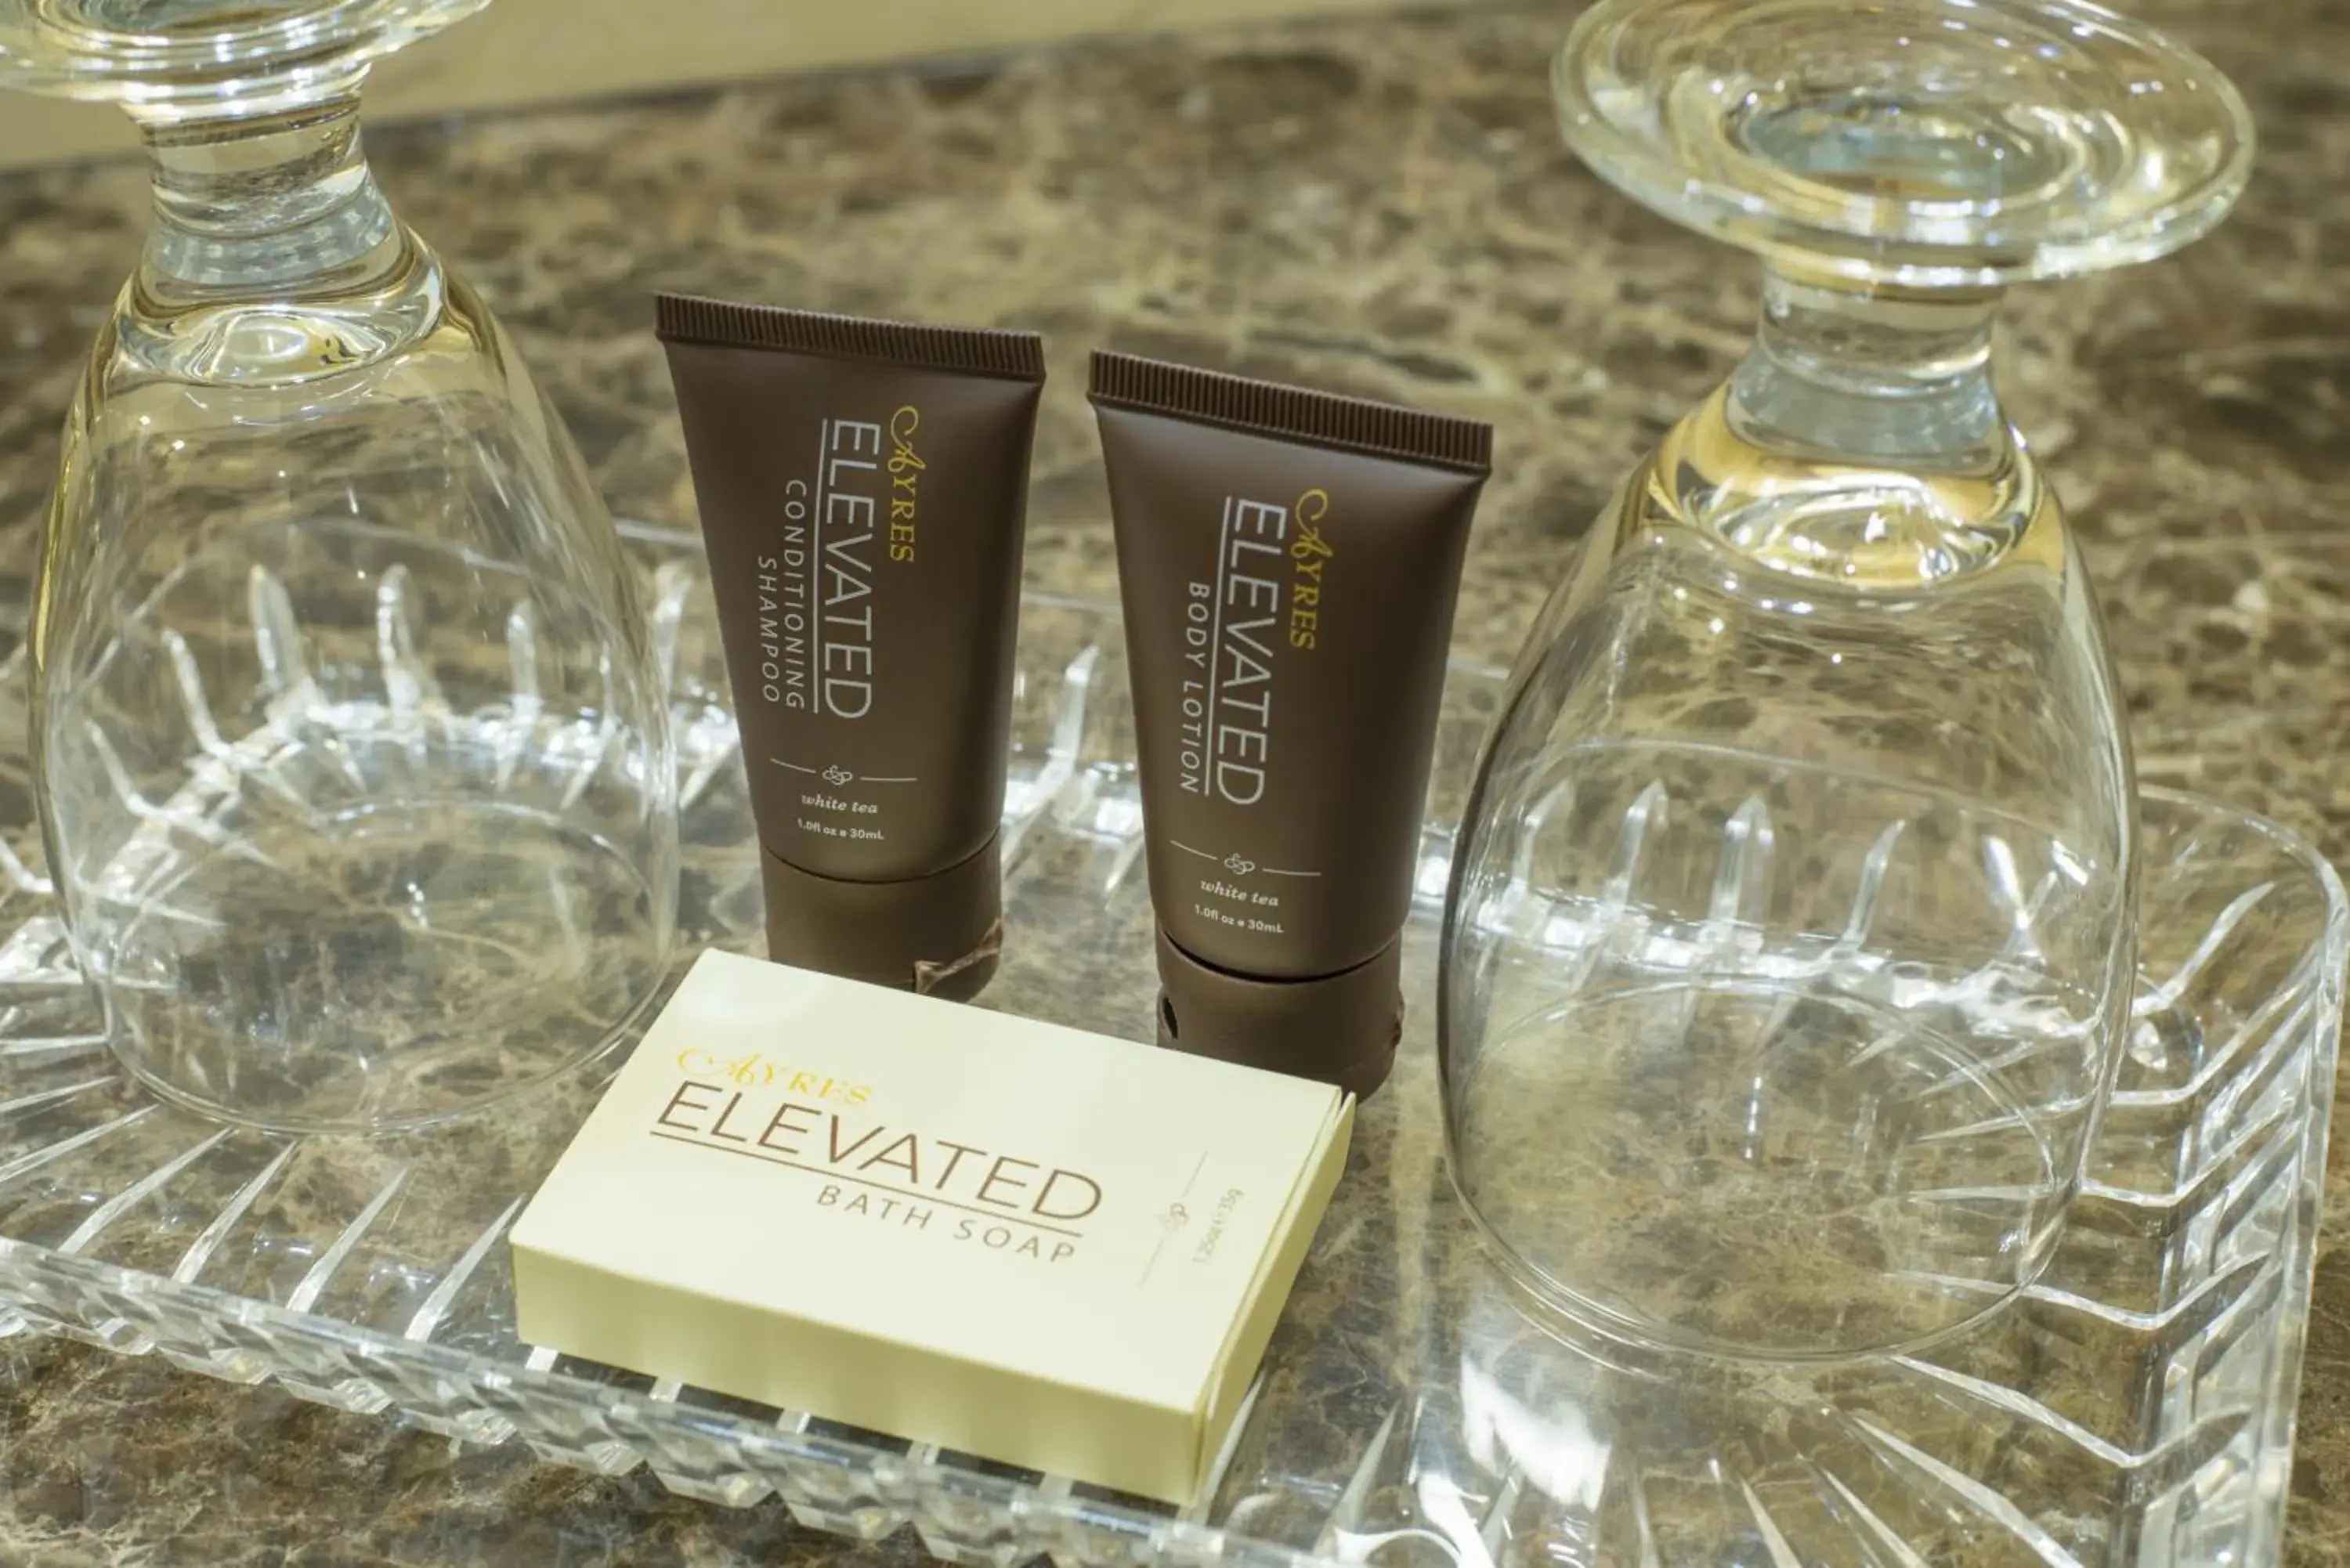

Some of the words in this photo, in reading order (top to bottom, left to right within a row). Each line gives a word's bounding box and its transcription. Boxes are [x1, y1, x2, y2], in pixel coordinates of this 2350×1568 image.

[888, 405, 926, 563] AYRES
[757, 555, 780, 703] SHAMPOO
[784, 479, 808, 710] CONDITIONING
[825, 419, 881, 719] ELEVATED
[1184, 581, 1210, 668] BODY
[1290, 488, 1333, 650] AYRES
[1217, 498, 1287, 805] ELEVATED
[801, 793, 848, 812] white
[851, 801, 878, 814] tea
[1179, 680, 1203, 793] LOTION
[1200, 880, 1249, 901] white
[1253, 892, 1279, 906] tea
[677, 1046, 874, 1106] AYRES
[657, 1080, 1103, 1220] ELEVATED
[817, 1184, 933, 1230] BATH
[953, 1219, 1076, 1264] SOAP
